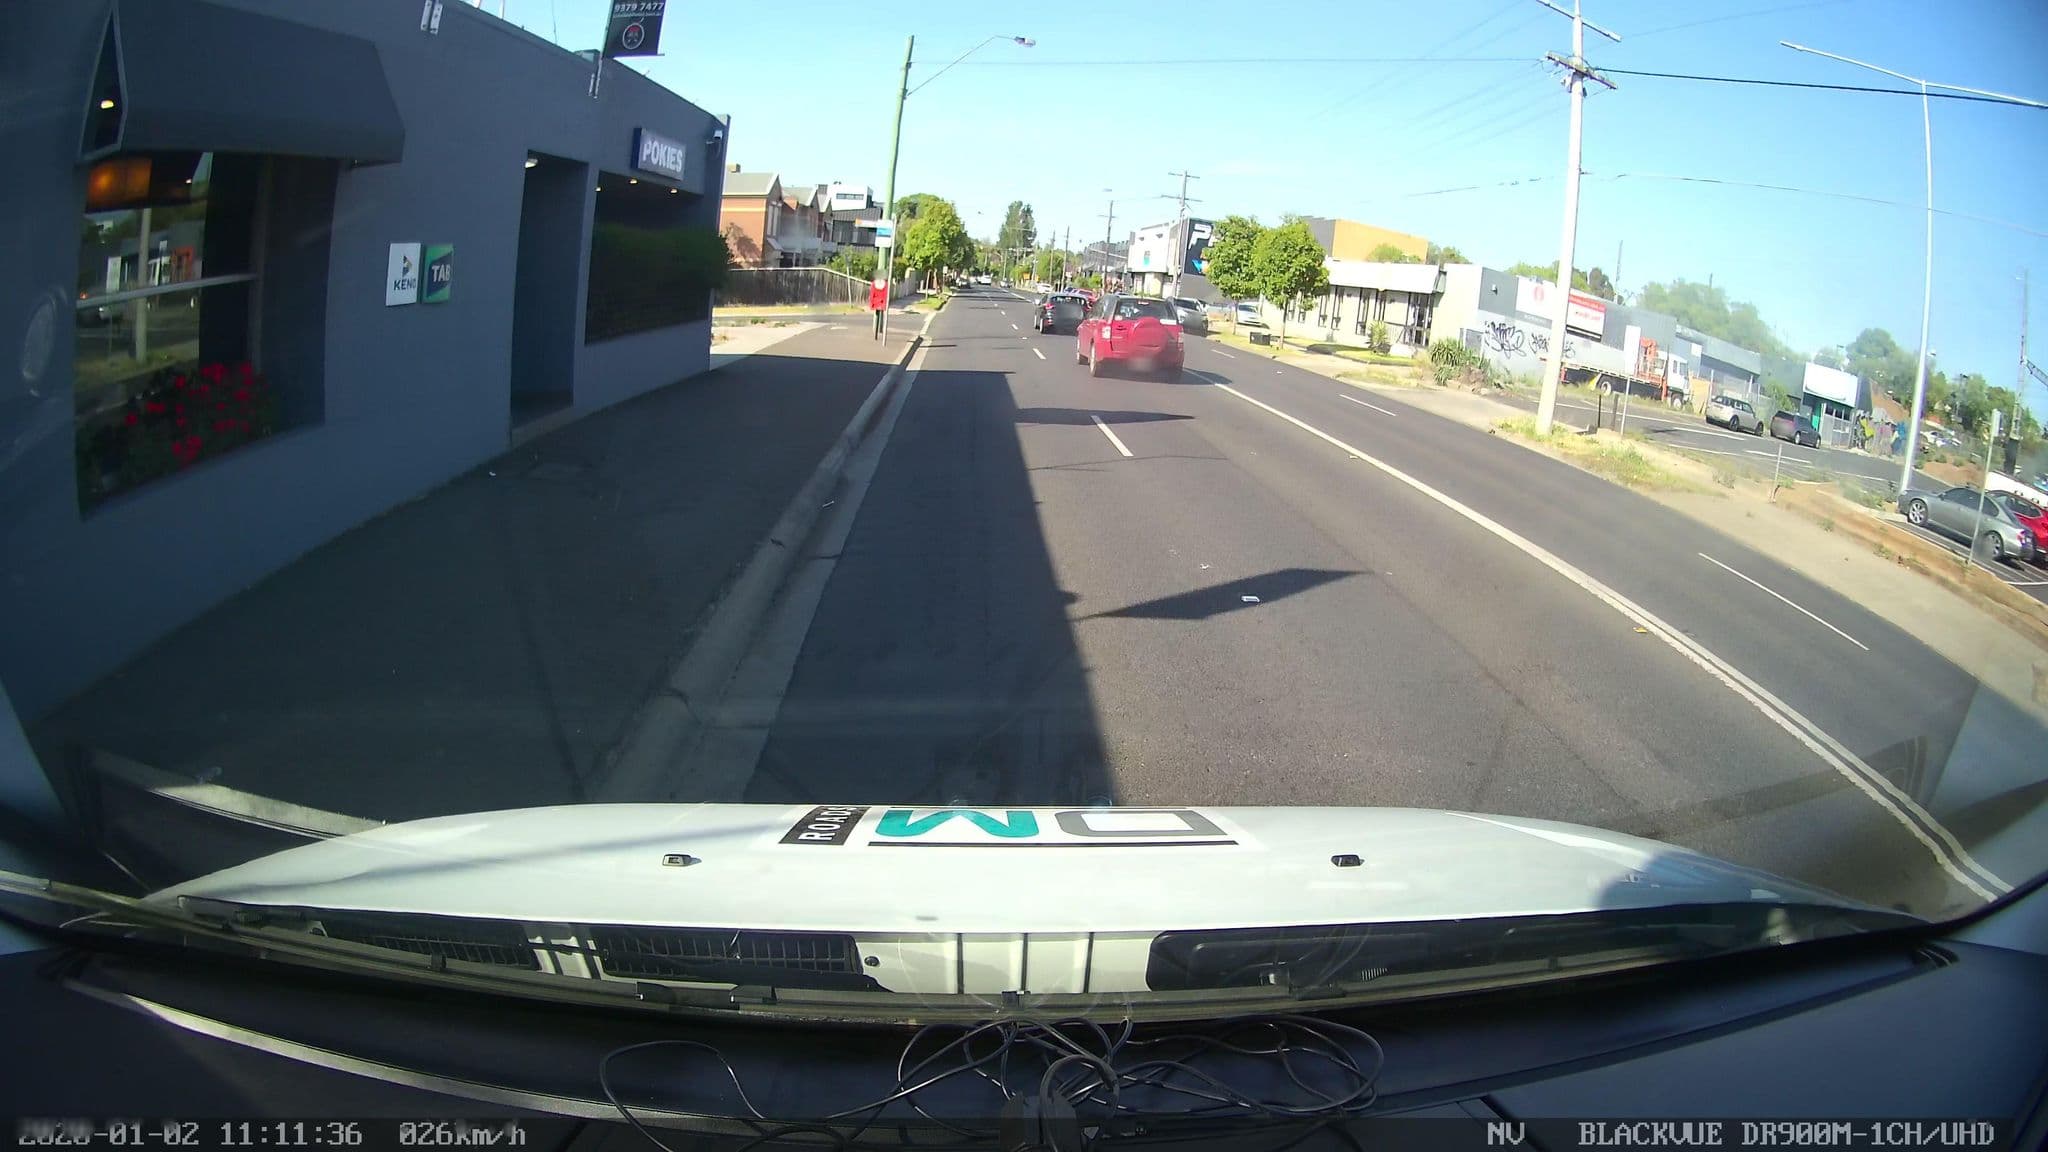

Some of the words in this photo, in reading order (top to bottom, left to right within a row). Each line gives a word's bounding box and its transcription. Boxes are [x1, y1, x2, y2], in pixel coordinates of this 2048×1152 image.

[640, 2, 665, 11] 7477
[642, 140, 683, 172] POKIES
[431, 263, 451, 282] TAB
